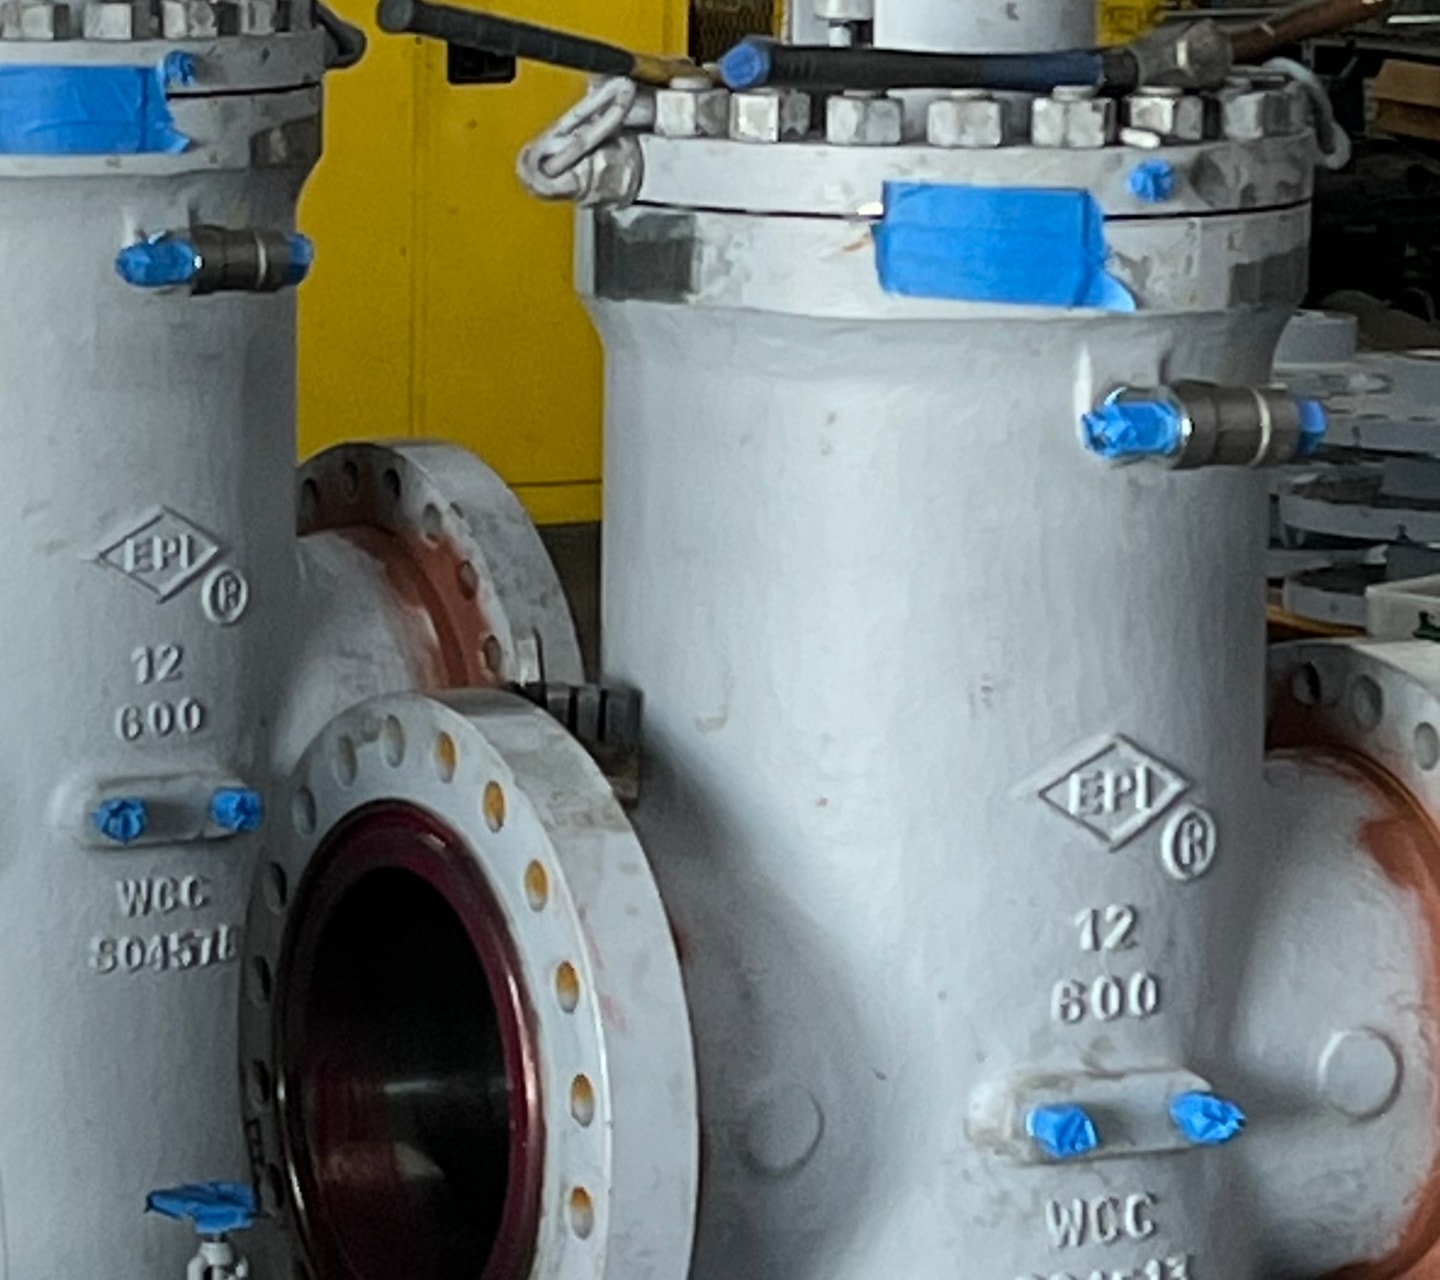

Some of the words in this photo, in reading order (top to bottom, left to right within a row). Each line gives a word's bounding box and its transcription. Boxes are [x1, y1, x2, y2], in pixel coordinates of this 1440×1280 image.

[124, 533, 195, 572] EPI
[130, 643, 184, 685] 12
[115, 691, 206, 742] 600
[1068, 763, 1155, 818] EPI
[115, 874, 210, 917] WCC
[1073, 904, 1140, 952] 12
[1050, 971, 1161, 1024] 600
[1045, 1192, 1159, 1248] WCC
